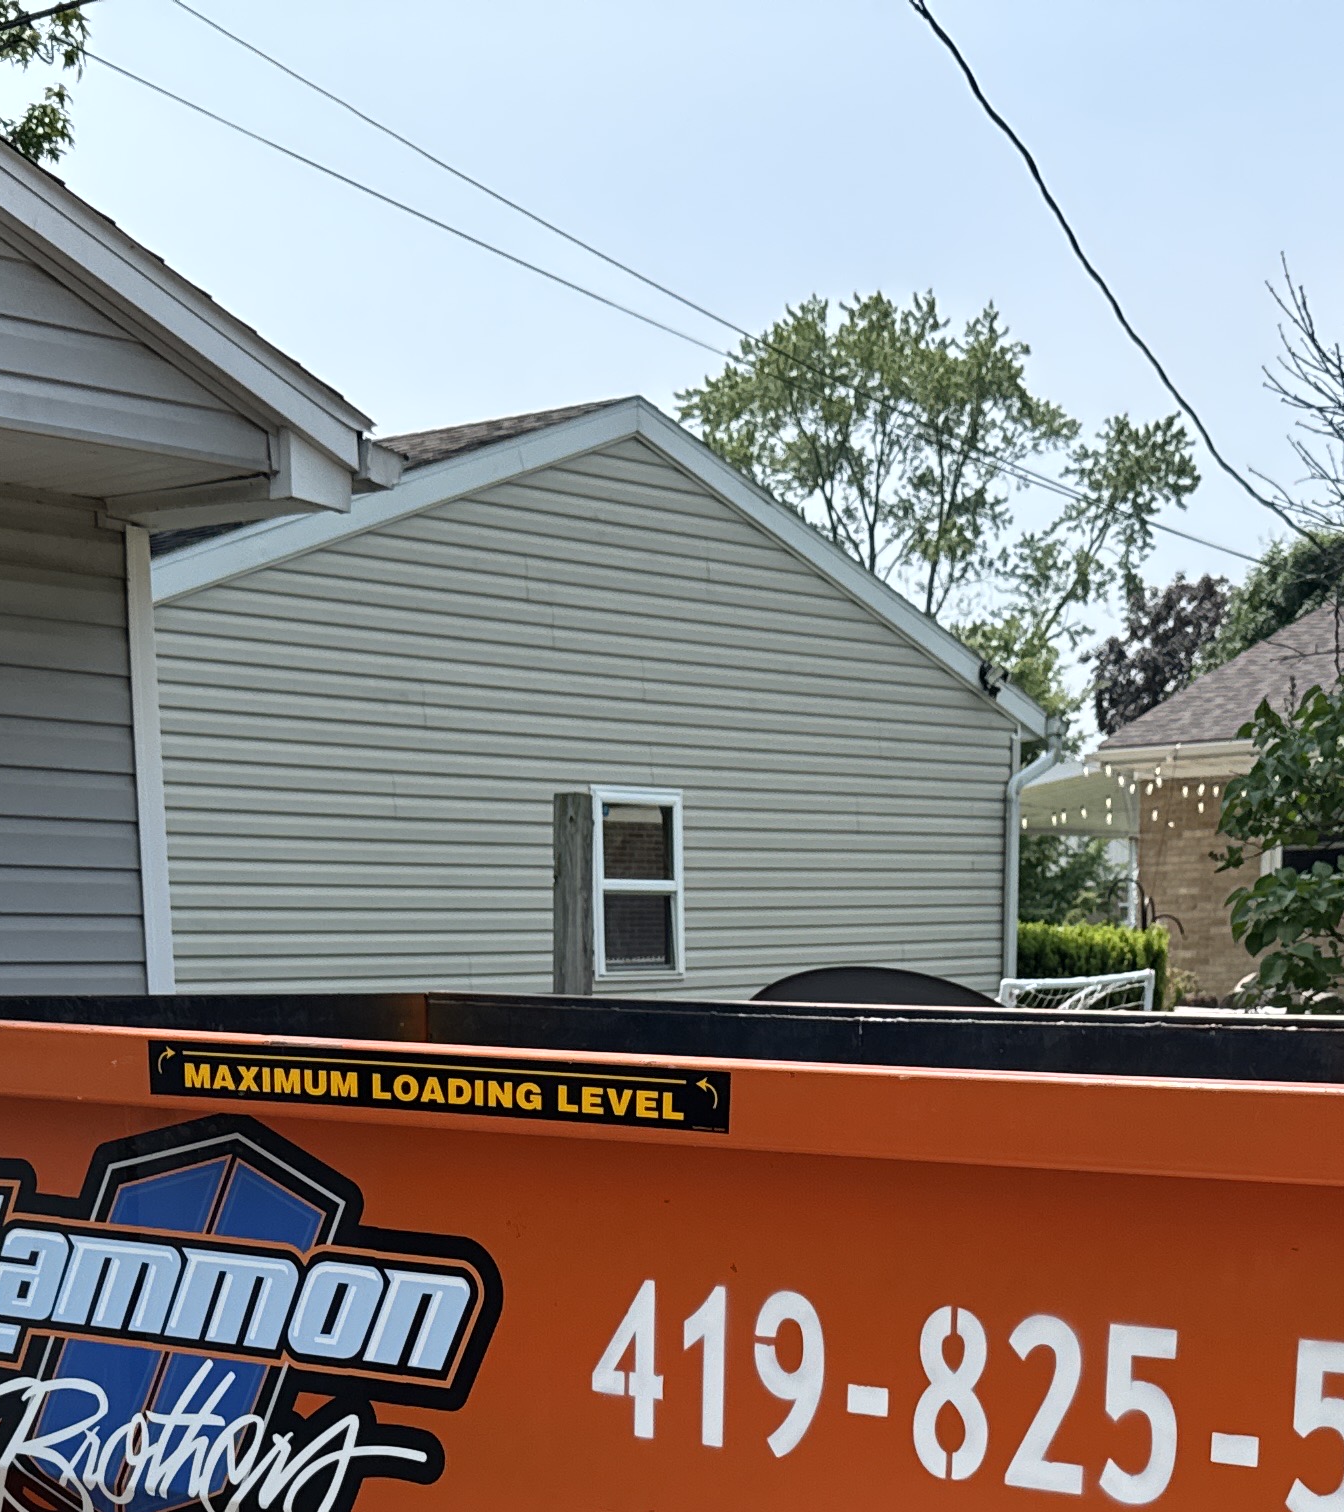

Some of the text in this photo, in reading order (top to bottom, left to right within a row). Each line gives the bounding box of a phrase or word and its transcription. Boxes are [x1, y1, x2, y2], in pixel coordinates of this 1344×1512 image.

[183, 1062, 685, 1122] MAXIMUM LOADING LEVEL
